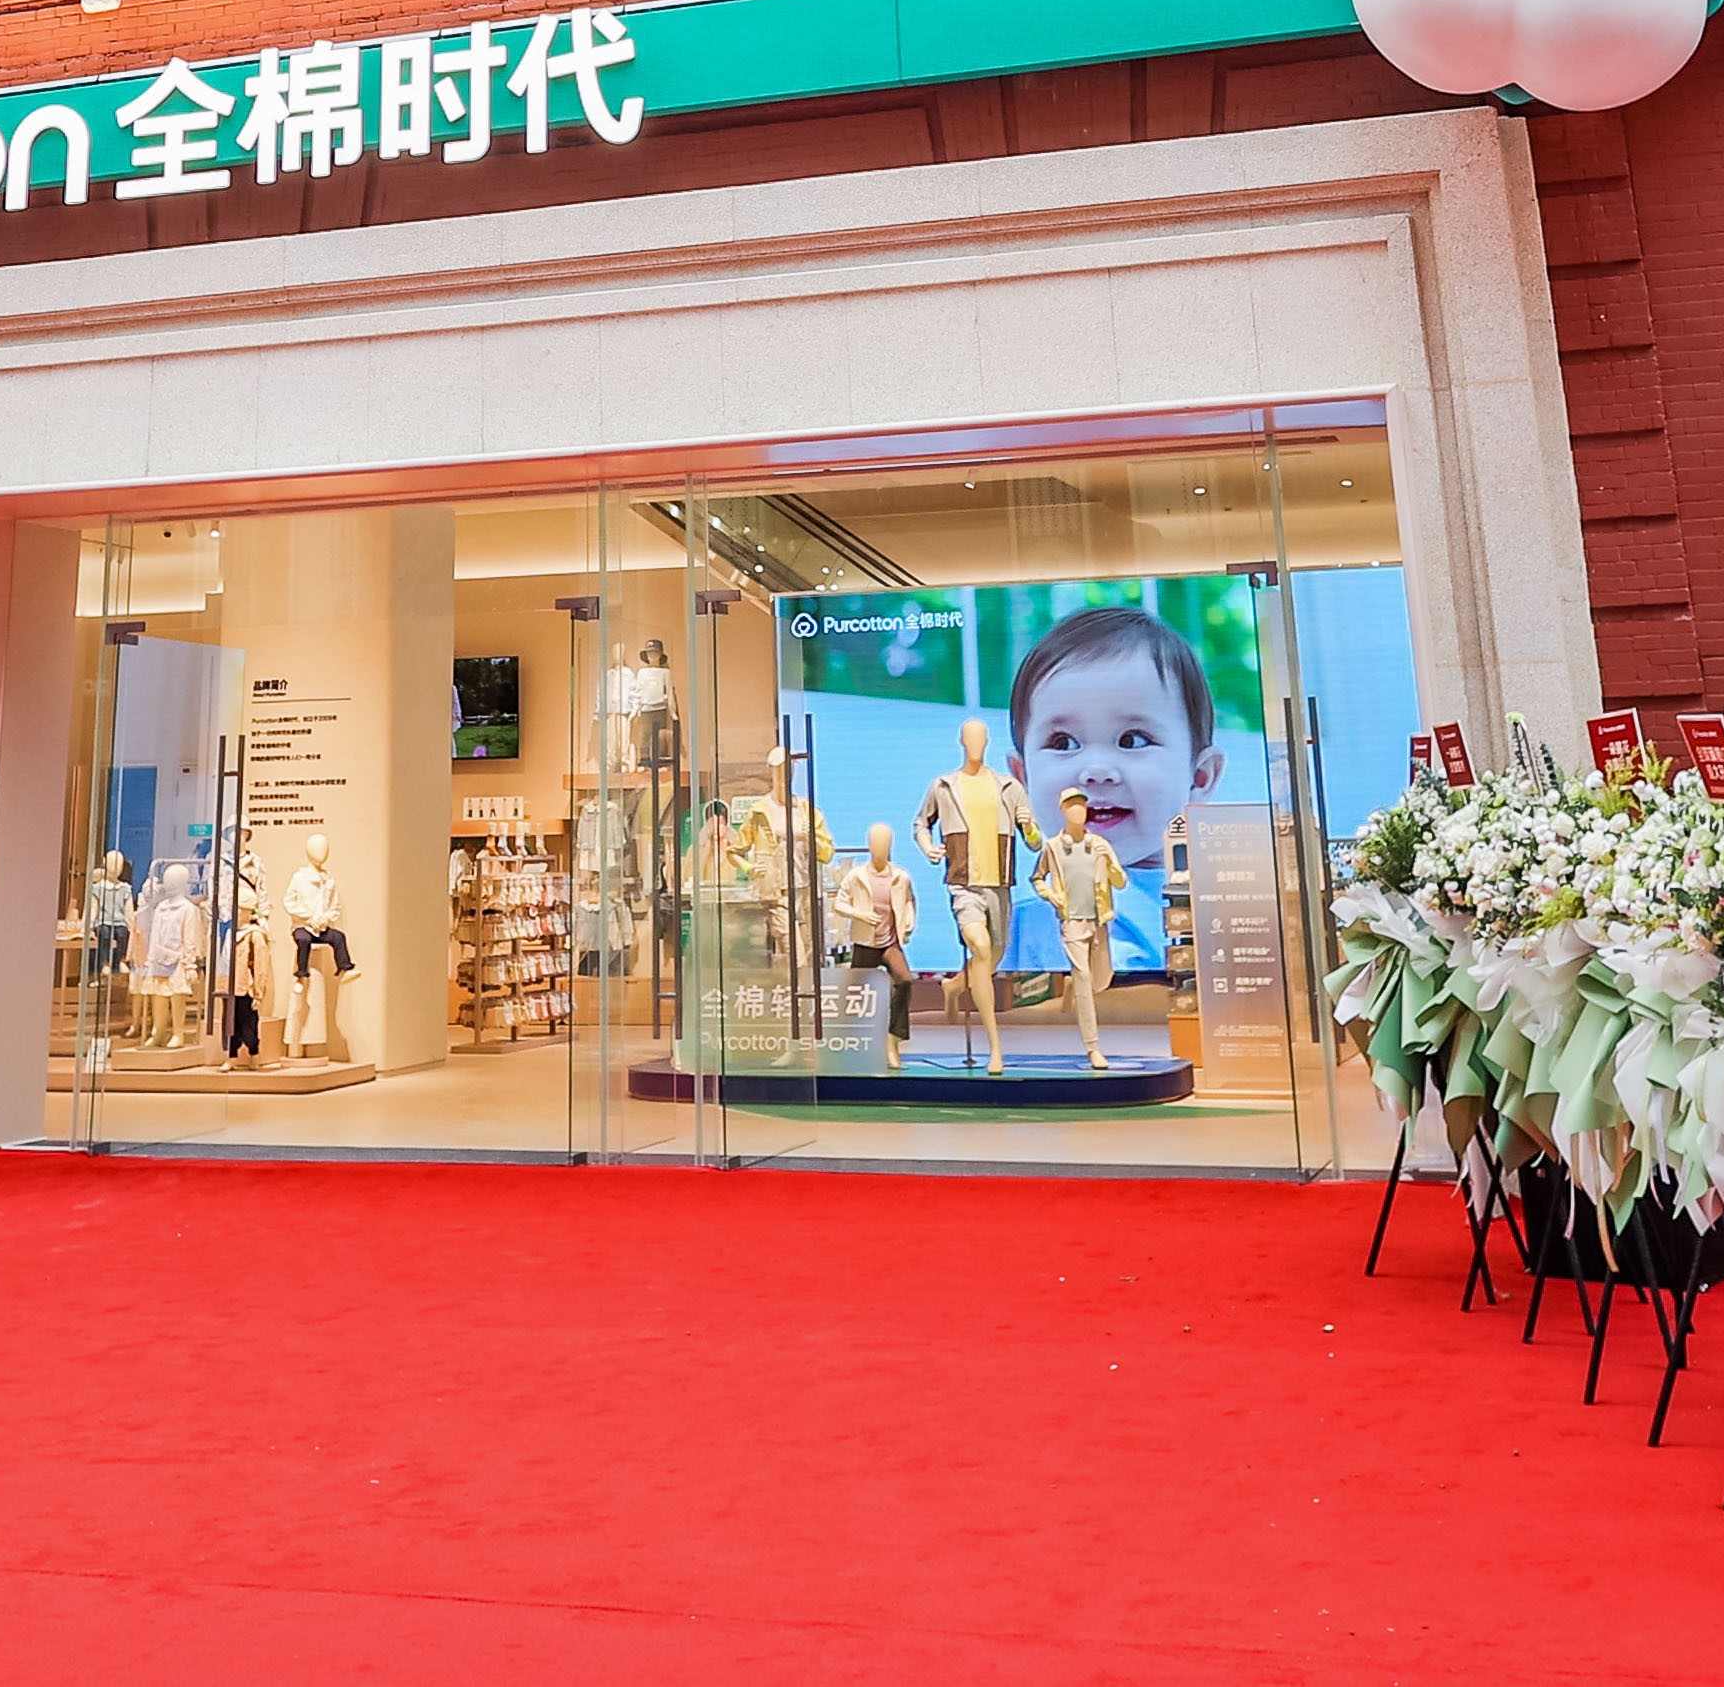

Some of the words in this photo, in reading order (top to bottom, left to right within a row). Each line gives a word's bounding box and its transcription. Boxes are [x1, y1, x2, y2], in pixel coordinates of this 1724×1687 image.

[114, 8, 646, 201] 全棉时代
[823, 616, 904, 634] Purcotton
[904, 611, 964, 630] 全棉时代
[252, 679, 288, 692] 品牌简介
[799, 1036, 873, 1051] SPORT
